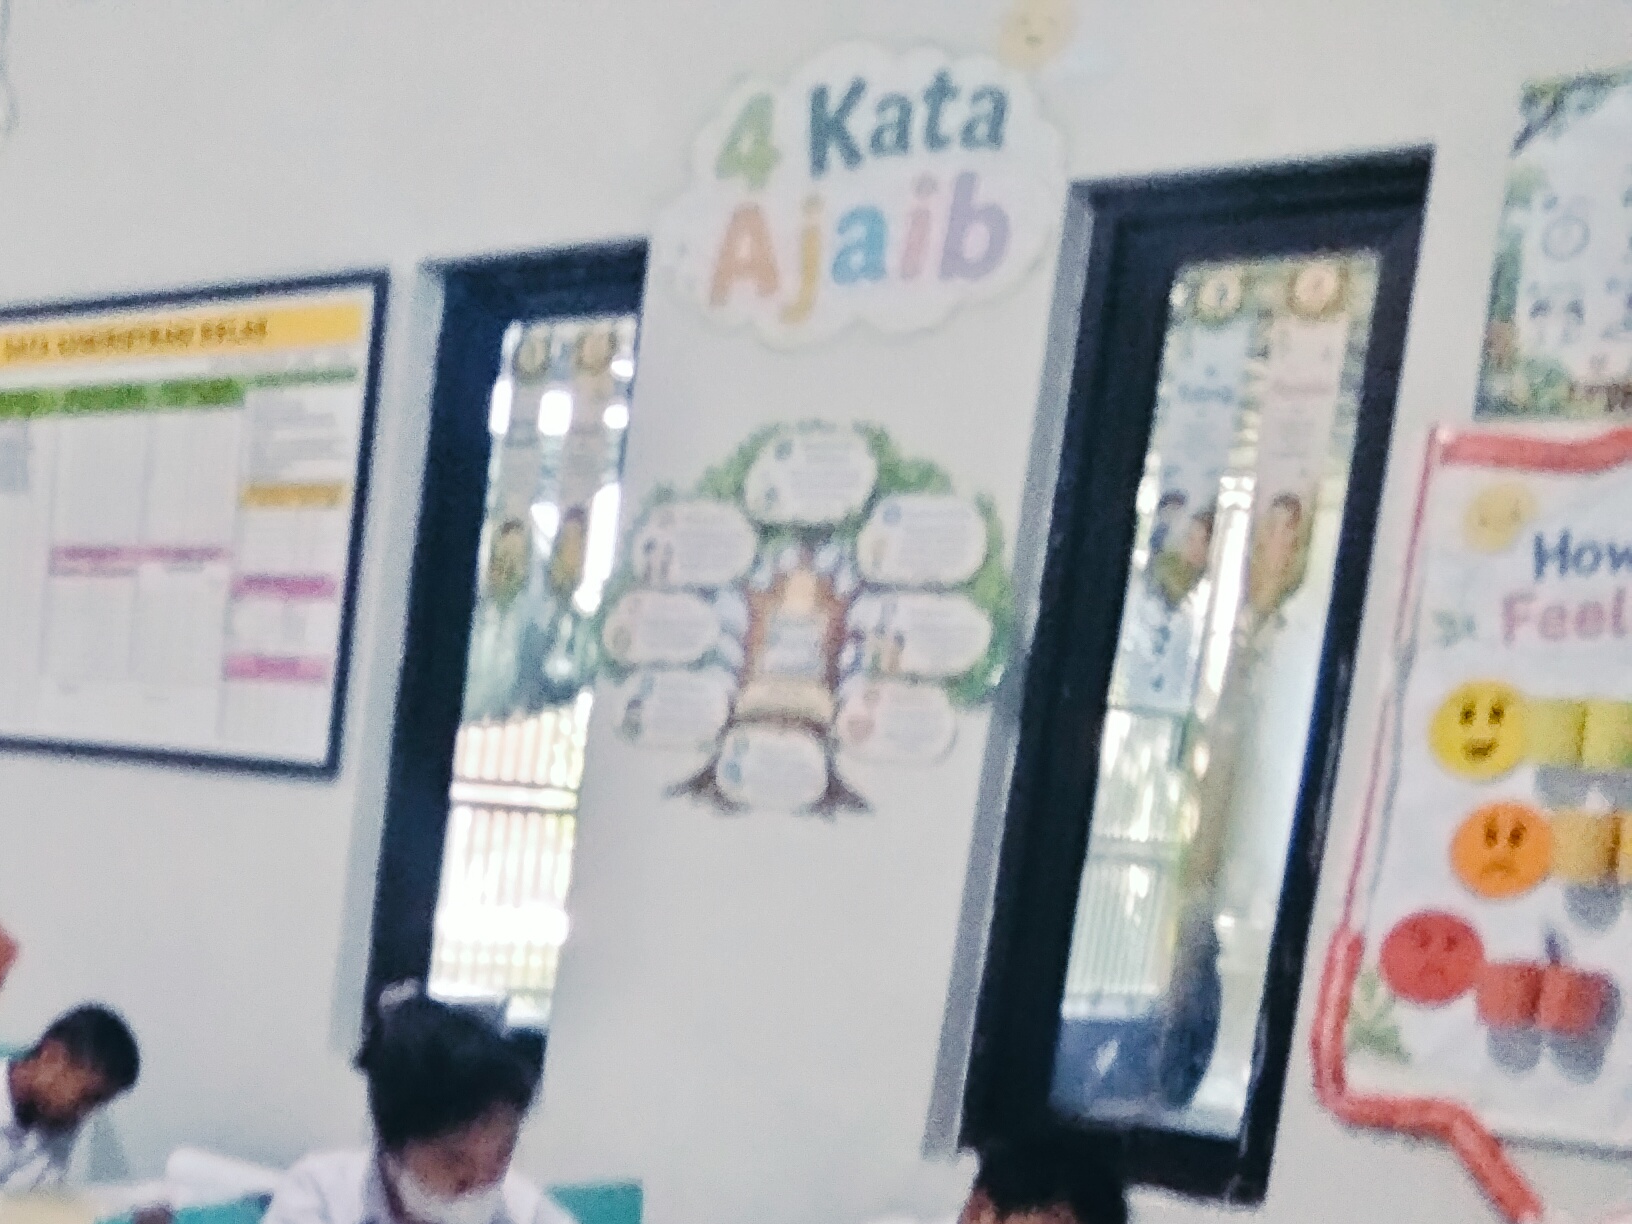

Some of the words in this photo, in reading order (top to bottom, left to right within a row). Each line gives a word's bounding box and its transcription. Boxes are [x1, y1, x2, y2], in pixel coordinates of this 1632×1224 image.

[712, 91, 781, 190] 4
[809, 68, 1010, 178] Kata
[708, 171, 1011, 325] Ajaib
